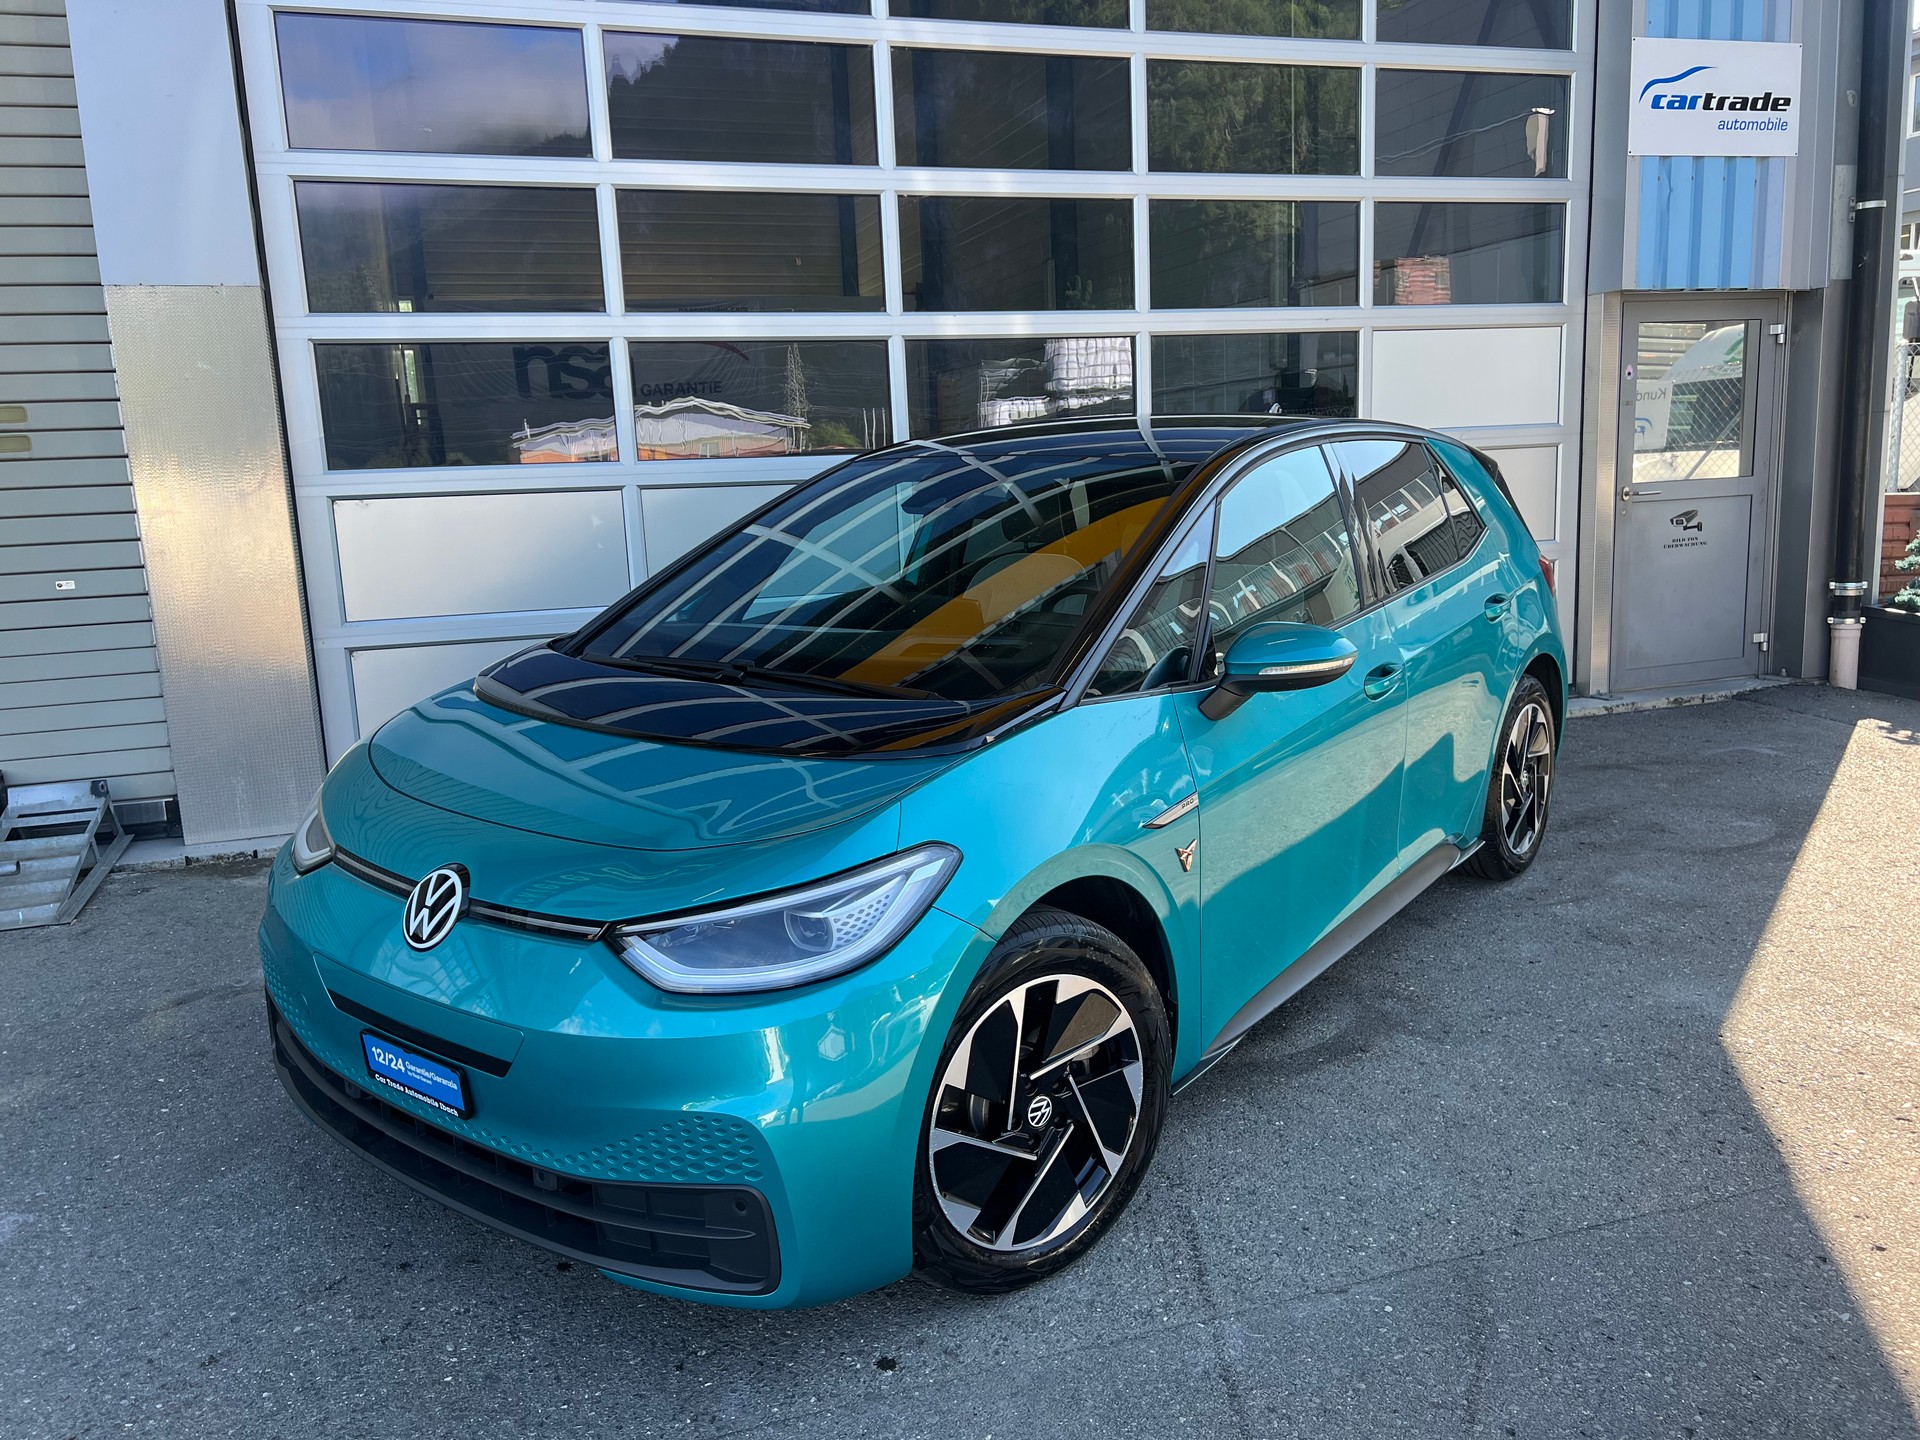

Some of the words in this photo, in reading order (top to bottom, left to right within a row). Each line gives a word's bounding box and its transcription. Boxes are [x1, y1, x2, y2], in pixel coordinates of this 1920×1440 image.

[1651, 92, 1791, 112] cartrade
[1717, 117, 1788, 131] automobile
[640, 381, 722, 397] GARANTIE
[1181, 798, 1194, 809] PRO
[371, 1046, 405, 1073] 12/24
[405, 1061, 458, 1090] Garantie/Garanzia
[375, 1073, 386, 1083] Car
[386, 1079, 404, 1092] Trade
[404, 1086, 439, 1108] Automobile
